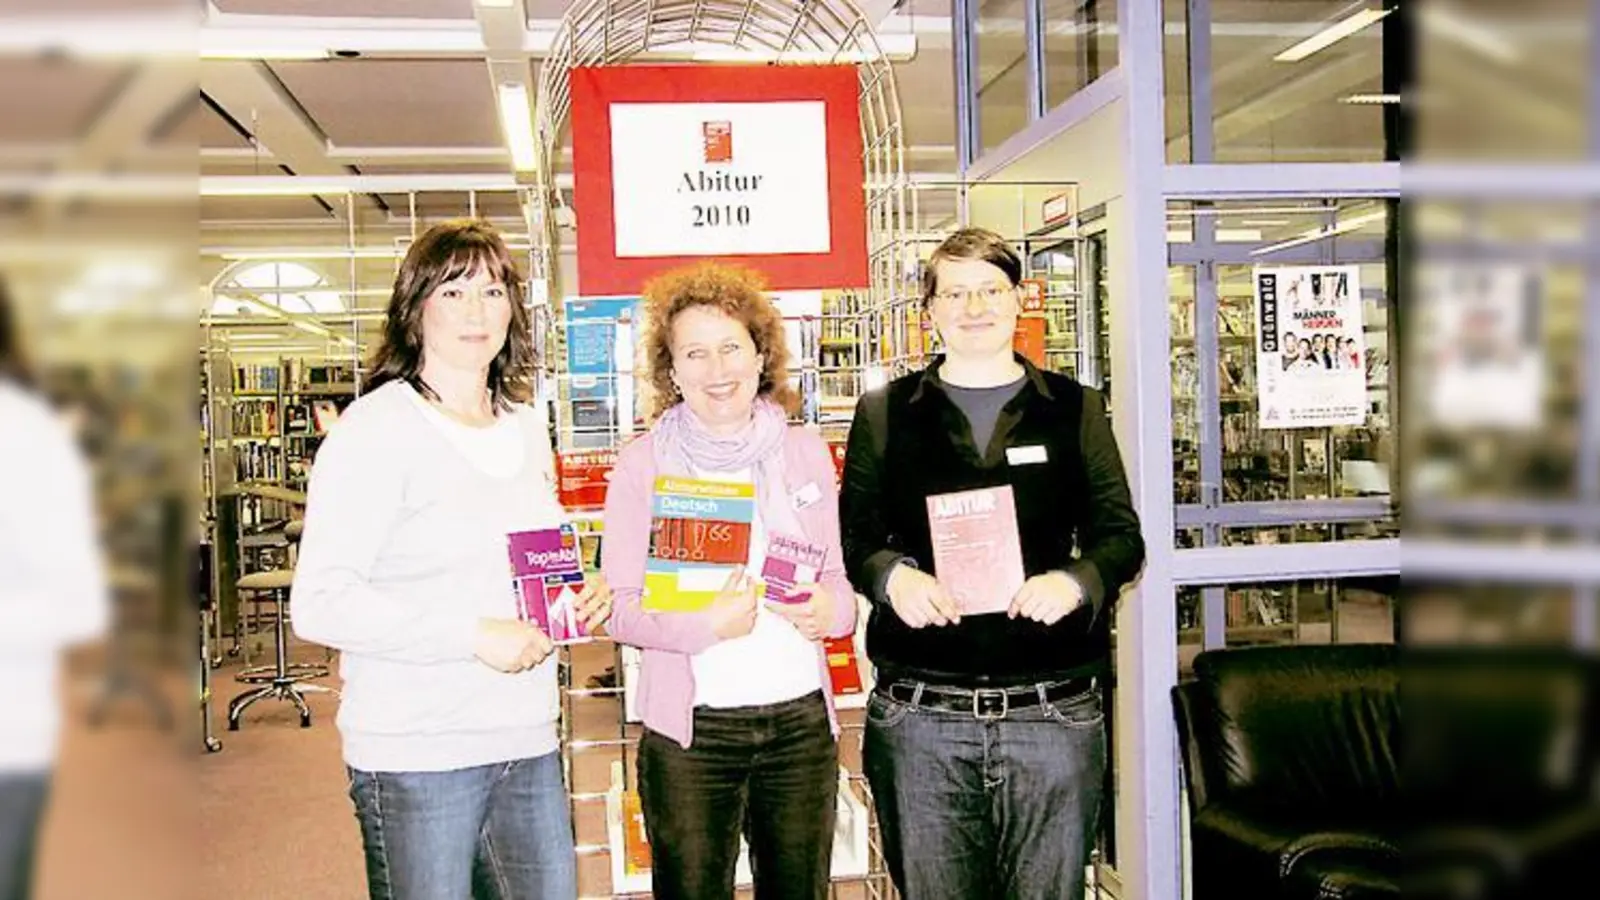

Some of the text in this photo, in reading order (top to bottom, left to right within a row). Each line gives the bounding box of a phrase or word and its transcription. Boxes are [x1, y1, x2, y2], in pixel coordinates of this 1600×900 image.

[677, 170, 763, 192] Abitur
[692, 204, 750, 227] 2010
[661, 496, 718, 514] Deutsch
